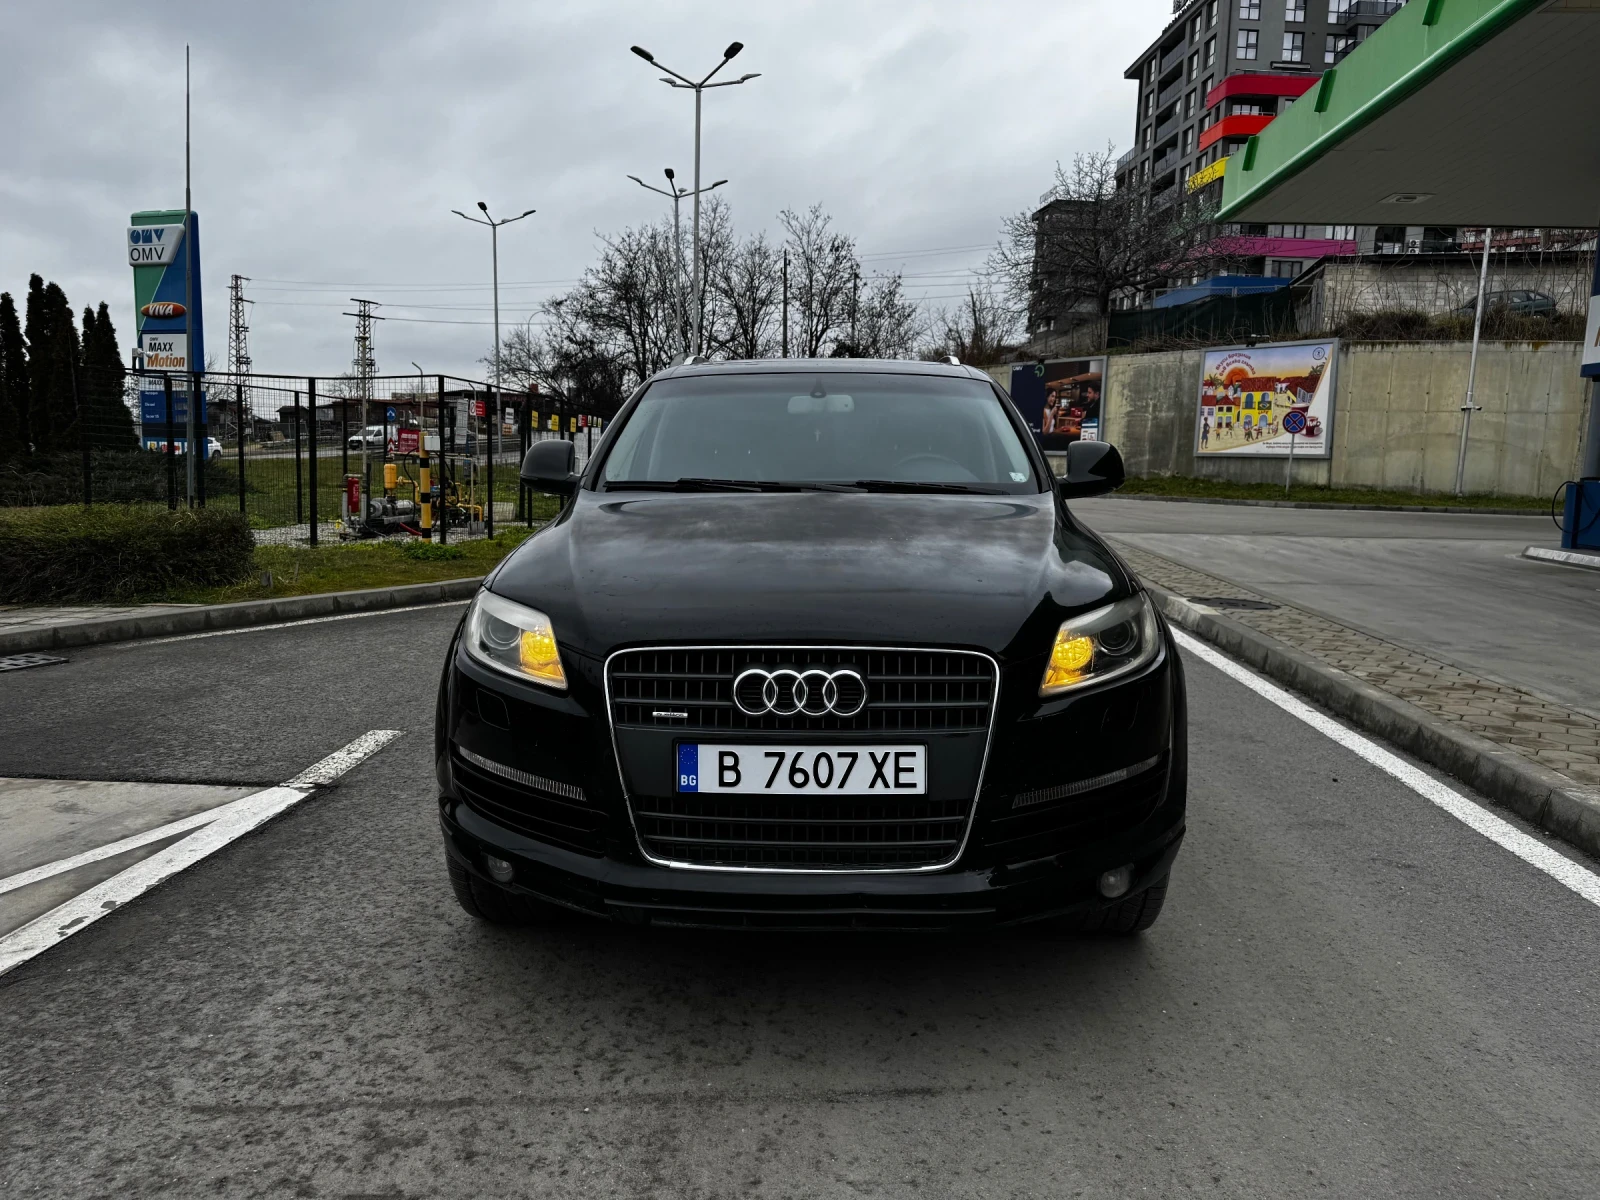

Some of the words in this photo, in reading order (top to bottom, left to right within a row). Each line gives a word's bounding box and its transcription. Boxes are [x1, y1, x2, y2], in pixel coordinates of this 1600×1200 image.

[130, 247, 165, 261] OMV
[148, 305, 174, 316] VIVA
[149, 342, 173, 352] MAXX
[147, 353, 185, 367] Motion
[718, 751, 741, 787] B
[764, 752, 859, 789] 7607
[868, 752, 917, 789] XE
[680, 775, 697, 786] BG
